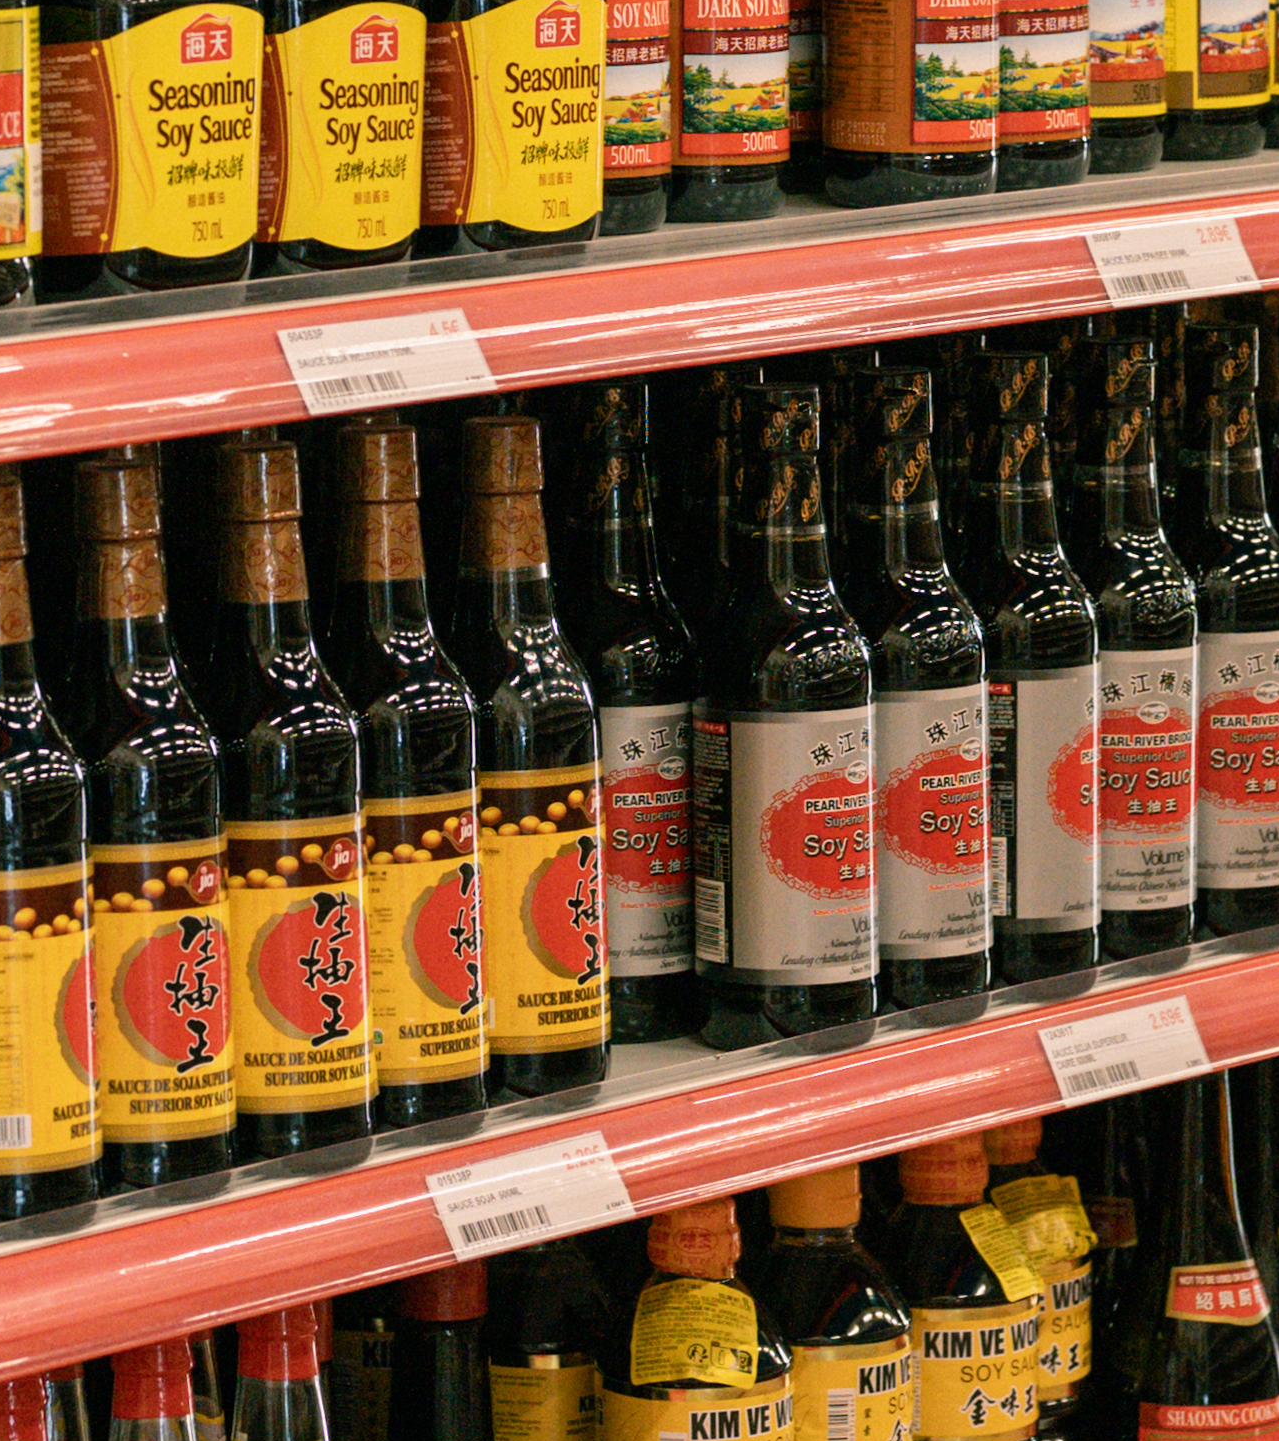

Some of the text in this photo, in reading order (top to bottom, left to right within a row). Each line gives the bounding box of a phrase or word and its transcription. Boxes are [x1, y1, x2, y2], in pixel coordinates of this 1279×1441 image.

[540, 17, 579, 44] 海天
[185, 31, 228, 59] 海天
[354, 31, 395, 59] 海天
[505, 57, 601, 98] Seasoning
[148, 73, 256, 113] Seasoning
[321, 72, 419, 115] Seasoning
[512, 99, 597, 136] Soy Sauce
[1045, 109, 1080, 128] 500mL
[157, 116, 251, 156] Soy Sauce
[326, 116, 414, 154] Soy Sauce
[742, 132, 778, 151] 500mL
[521, 137, 589, 165] 招牌味极鲜
[611, 145, 651, 164] 500mL
[167, 155, 244, 185] 招牌味极鲜
[335, 156, 407, 183] 招牌味极鲜
[1134, 734, 1163, 748] RIVER
[1113, 750, 1160, 766] Superior
[1211, 746, 1258, 772] Soy
[920, 775, 949, 790] PEARL
[613, 790, 683, 808] PEARL RIVER
[804, 798, 838, 814] PEARL
[1128, 797, 1178, 817] 生抽王
[920, 810, 964, 835] Soy
[611, 827, 660, 854] Soy
[804, 832, 848, 859] Soy
[332, 845, 351, 870] jia
[299, 891, 355, 1048] 生抽王
[164, 914, 219, 1074] 生抽王
[517, 992, 556, 1008] SAUCE
[538, 1007, 591, 1026] SUPERIOR
[399, 1024, 439, 1040] SAUCE
[244, 1048, 333, 1067] SAUCE DE SOJA
[420, 1039, 471, 1057] SUPERIOR
[108, 1075, 202, 1095] SAUCE DE SOJA
[265, 1068, 349, 1087] SUPERIOR SOY
[130, 1096, 192, 1114] SUPERIOR
[924, 1327, 997, 1358] KIM VE
[859, 1364, 893, 1395] KIM
[960, 1362, 1006, 1384] SOY
[690, 1407, 771, 1441] KIM VE
[1167, 1408, 1234, 1426] SHAOXING
